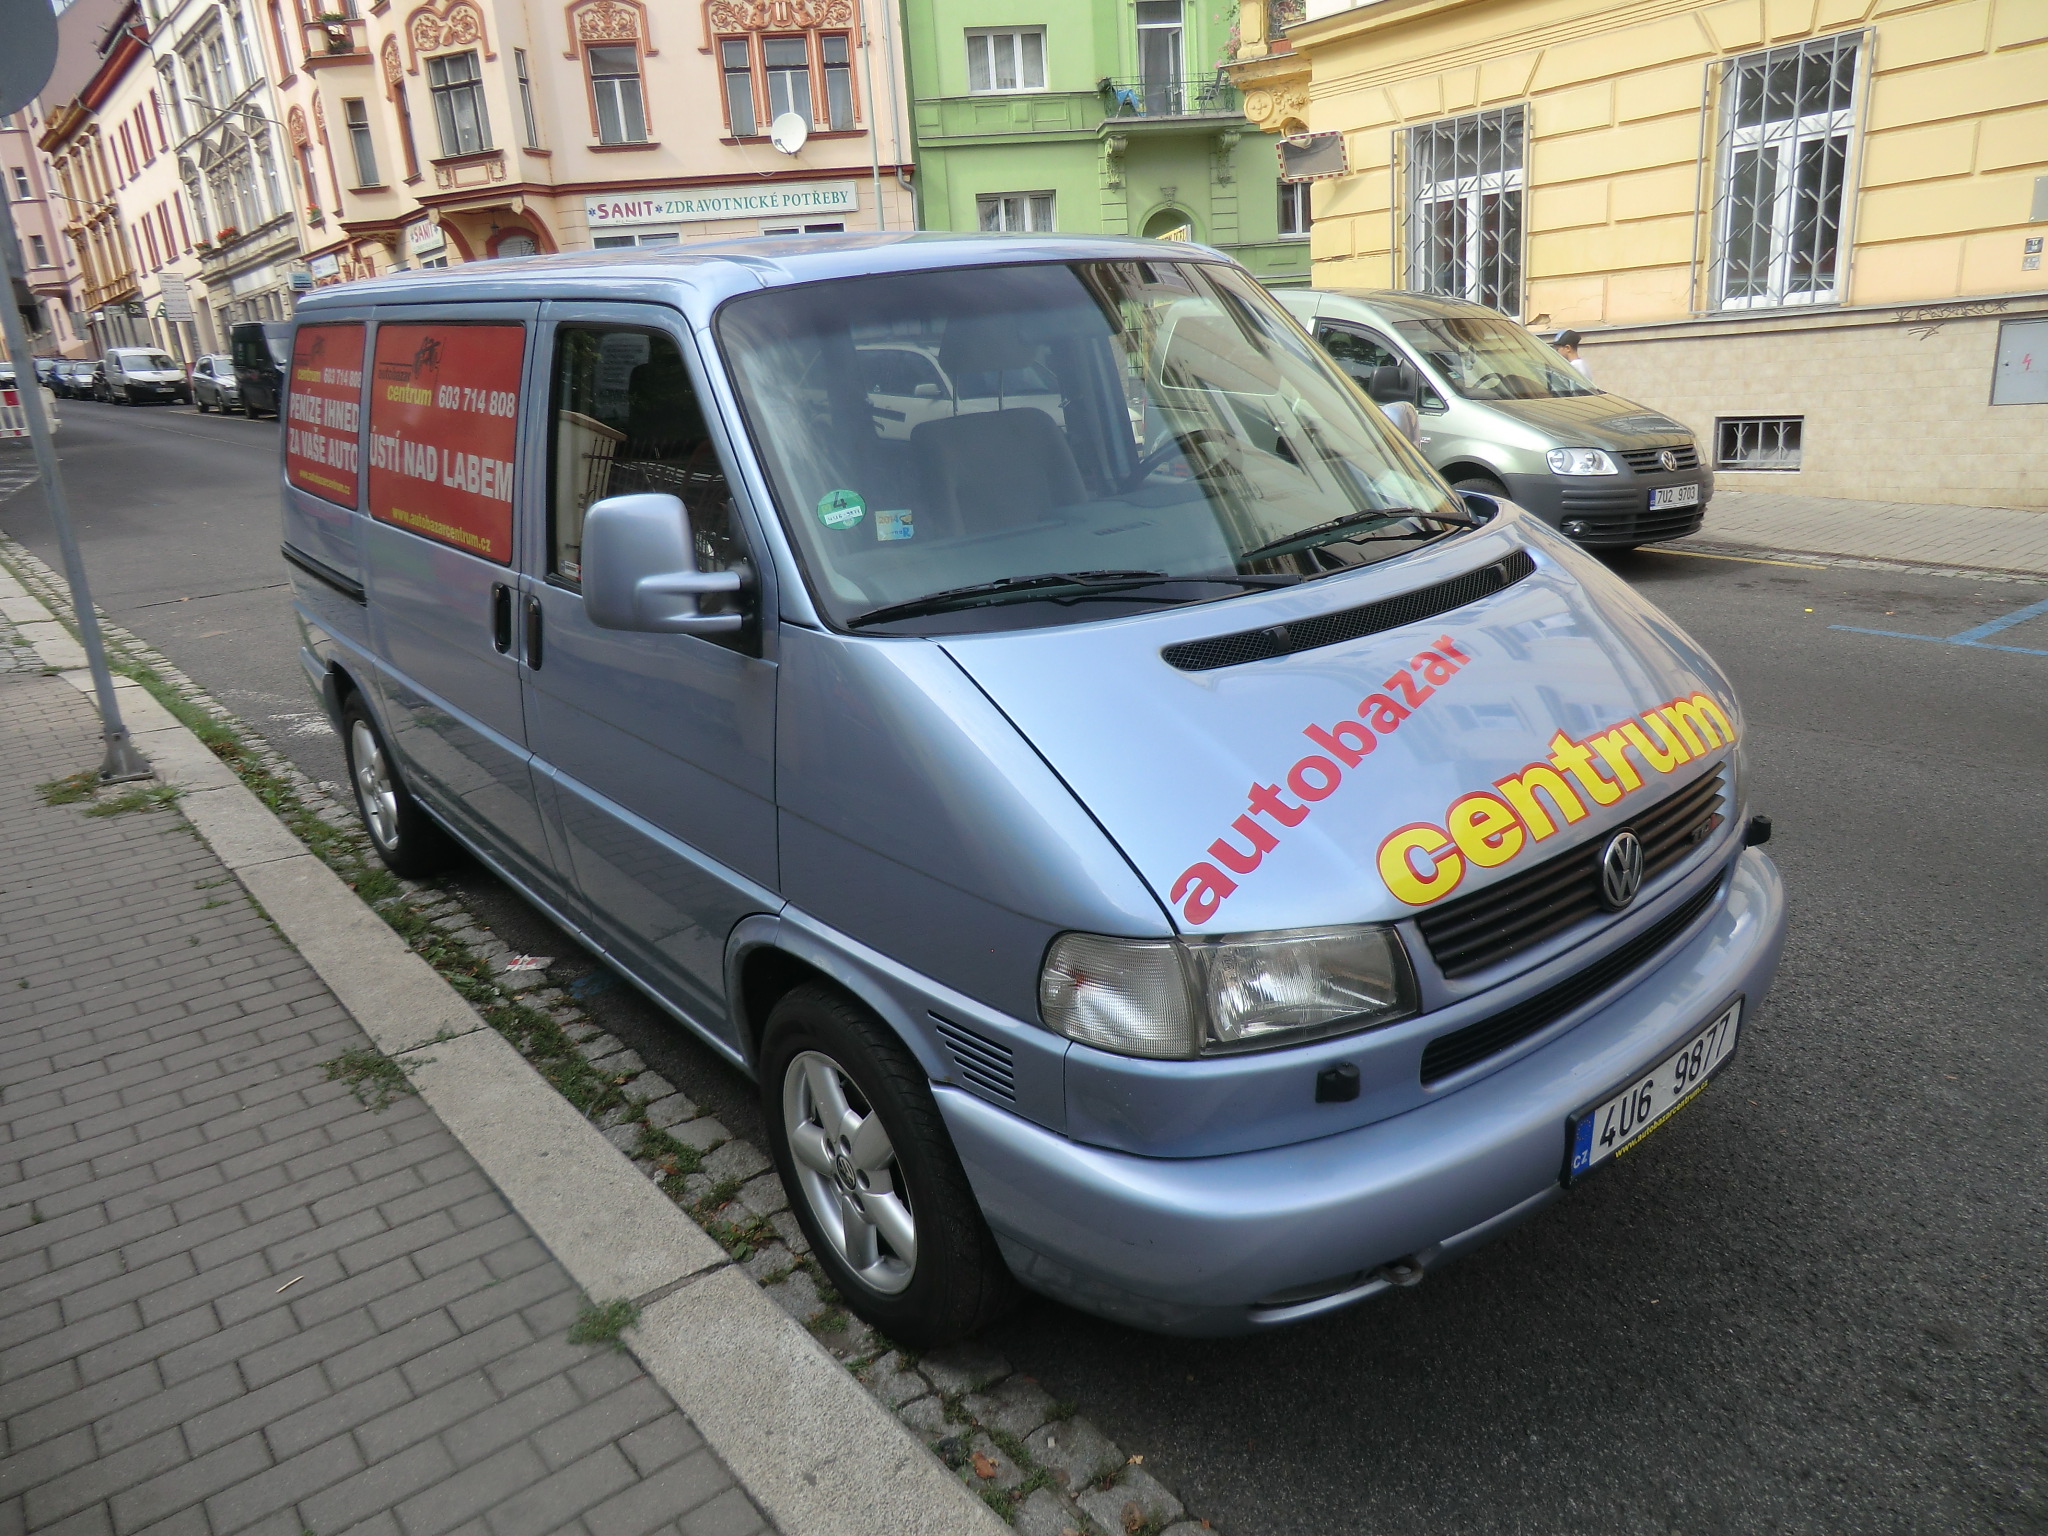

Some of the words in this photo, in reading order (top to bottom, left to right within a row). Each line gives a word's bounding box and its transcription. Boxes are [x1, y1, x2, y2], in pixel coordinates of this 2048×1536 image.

[597, 200, 654, 220] SANIT
[665, 191, 779, 214] ZDRAVOTNICKÉ
[782, 190, 849, 208] POTŘEBY
[413, 223, 434, 243] SANIT
[290, 387, 322, 425] PENÍZE
[324, 398, 360, 433] IHNED
[387, 383, 432, 406] centrum
[438, 385, 460, 410] 603
[463, 387, 486, 414] 714
[489, 390, 516, 418] 808
[290, 427, 300, 455] ZA
[301, 426, 326, 464] VAŠE
[328, 438, 359, 474] AUTO
[369, 425, 400, 473] ÚSTÍ
[404, 440, 438, 482] NAD
[443, 448, 514, 503] LABEM
[832, 491, 848, 508] 4
[1657, 489, 1673, 504] 7U2
[1678, 486, 1696, 501] 9703
[391, 507, 492, 553] www.autobazarcentrum.cz
[1169, 632, 1472, 926] autobazar
[1375, 690, 1736, 906] centrum
[1599, 1079, 1654, 1148] 4U6
[1672, 1011, 1732, 1095] 9877
[1615, 1079, 1709, 1159] www.autobazarcentrum.cz
[1573, 1149, 1589, 1169] CZ
